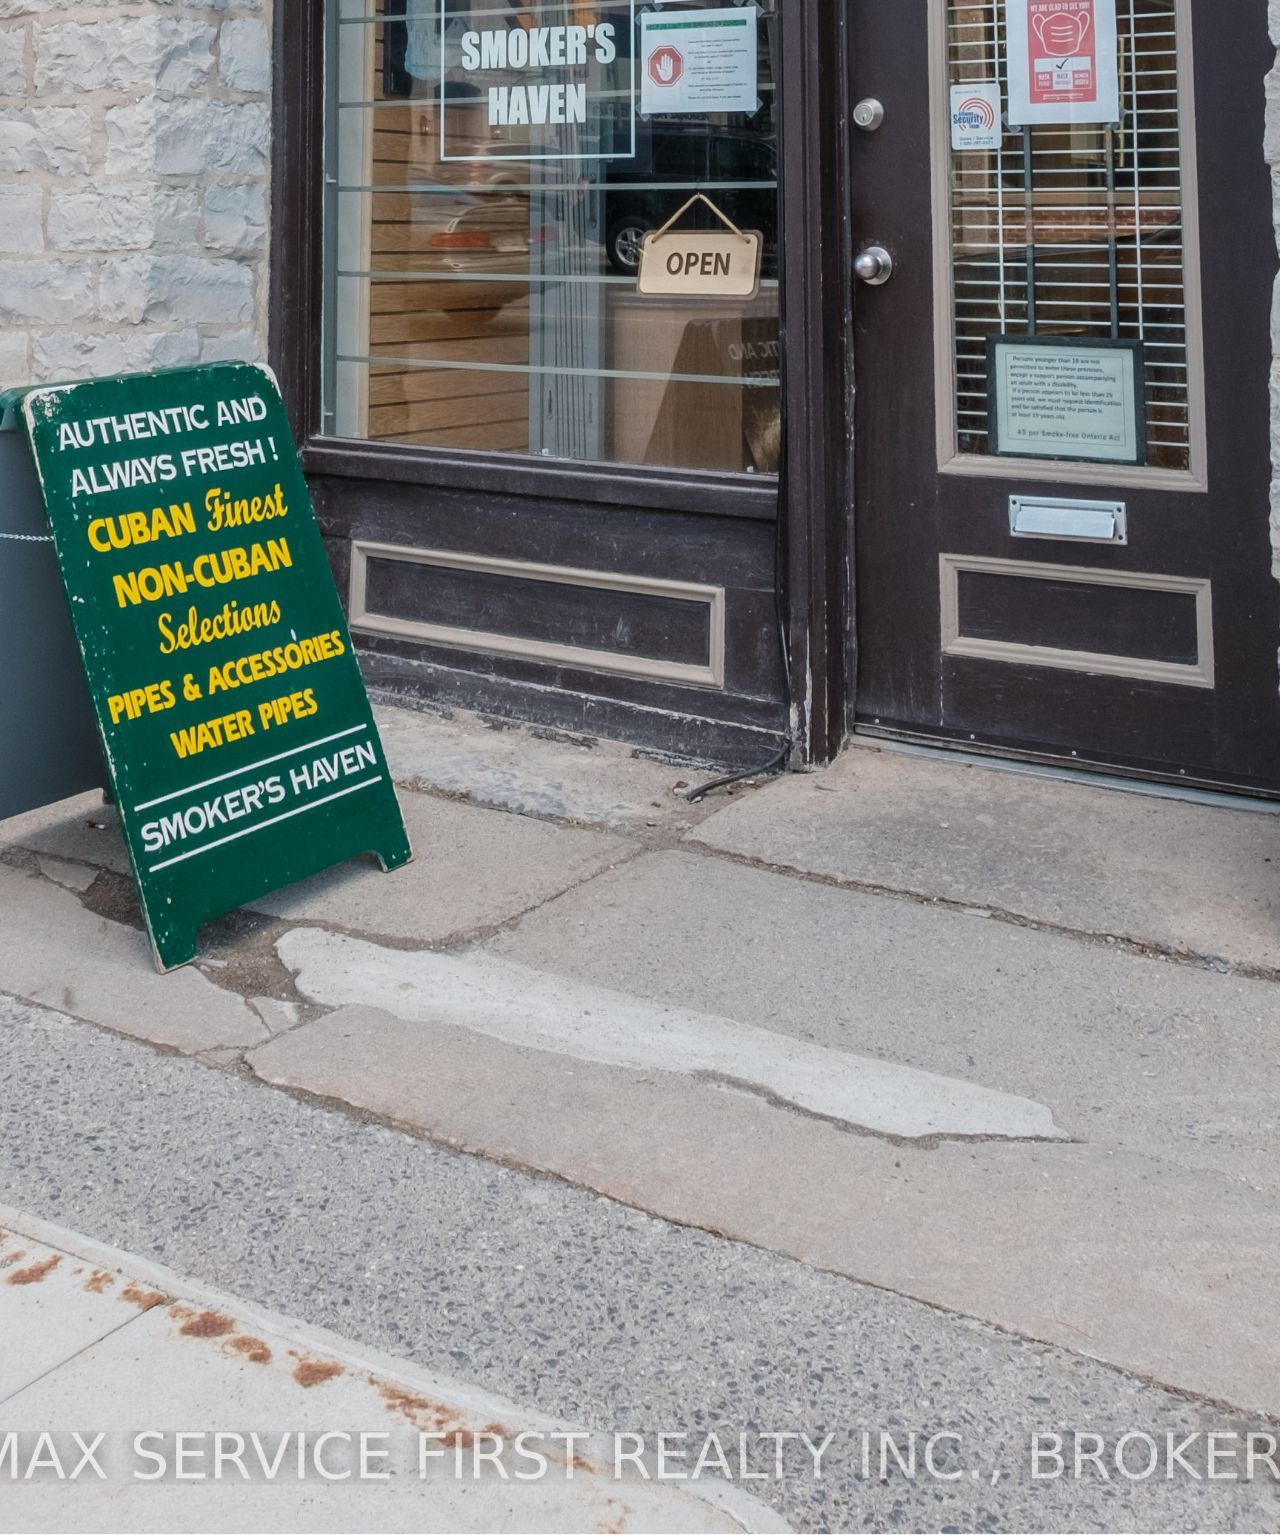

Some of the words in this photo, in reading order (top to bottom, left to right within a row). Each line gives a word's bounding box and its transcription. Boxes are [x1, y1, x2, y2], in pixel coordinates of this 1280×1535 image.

[1030, 4, 1038, 12] WE
[1039, 4, 1048, 12] ARE
[1048, 3, 1062, 12] GLAD
[1062, 2, 1069, 11] TO
[1069, 2, 1078, 10] SEE
[461, 22, 616, 71] SMOKER'S
[488, 83, 586, 126] HAVEN
[953, 113, 984, 125] Security
[666, 252, 731, 276] OPEN
[58, 404, 210, 451] AUTHENTIC
[217, 396, 268, 427] AND
[1041, 430, 1079, 439] Smoke-free
[1081, 432, 1108, 440] Ontario
[70, 454, 177, 498] ALWAYS
[86, 502, 196, 553] CUBAN
[205, 483, 288, 532] Finest
[112, 537, 293, 609] NON-CUBAN
[157, 599, 282, 654] Selections
[107, 680, 176, 725] PIPES
[182, 673, 203, 702] &
[208, 631, 346, 695] ACCESSORIES
[170, 710, 255, 759] WATER
[258, 688, 318, 730] PIPES
[289, 741, 377, 795] HAVEN
